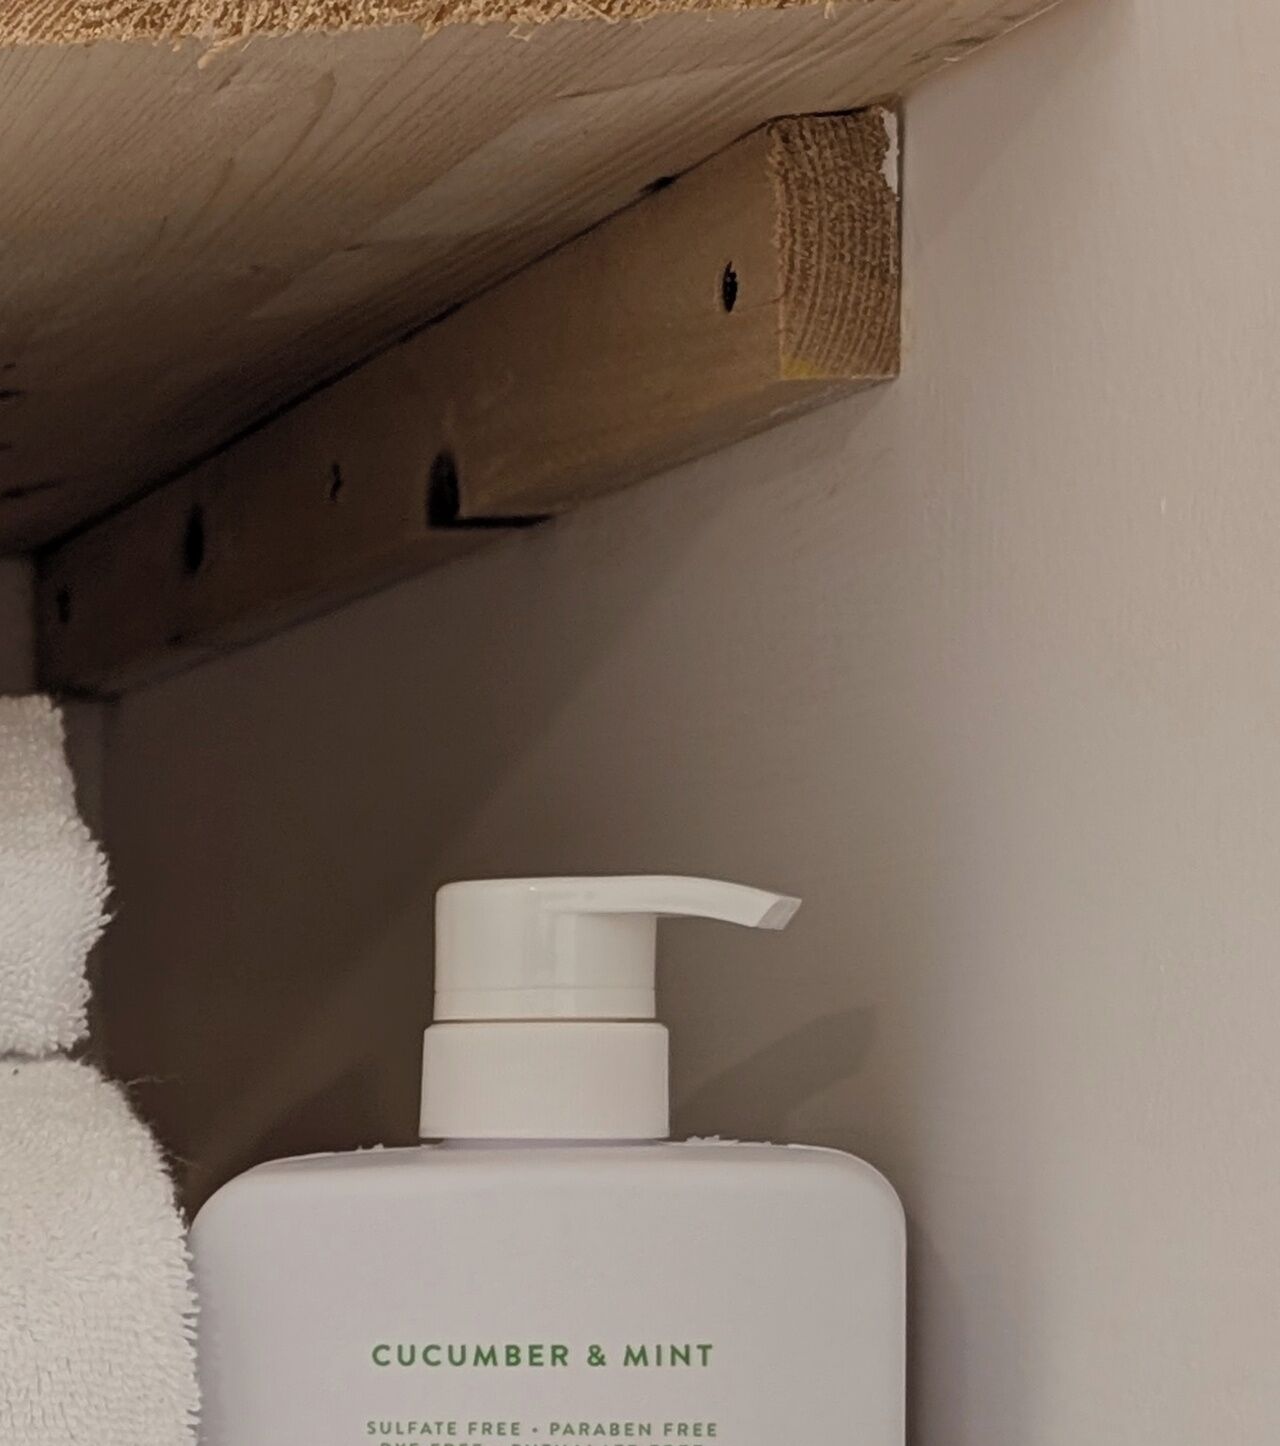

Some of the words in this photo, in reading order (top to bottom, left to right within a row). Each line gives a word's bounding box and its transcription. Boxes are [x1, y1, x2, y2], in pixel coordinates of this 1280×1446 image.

[371, 1343, 569, 1367] CUCUMBER
[586, 1344, 607, 1367] &
[623, 1343, 713, 1367] MINT
[366, 1420, 457, 1436] SULFATE
[467, 1421, 521, 1437] FREE
[549, 1421, 652, 1437] PARABEN
[663, 1422, 717, 1438] FREE
